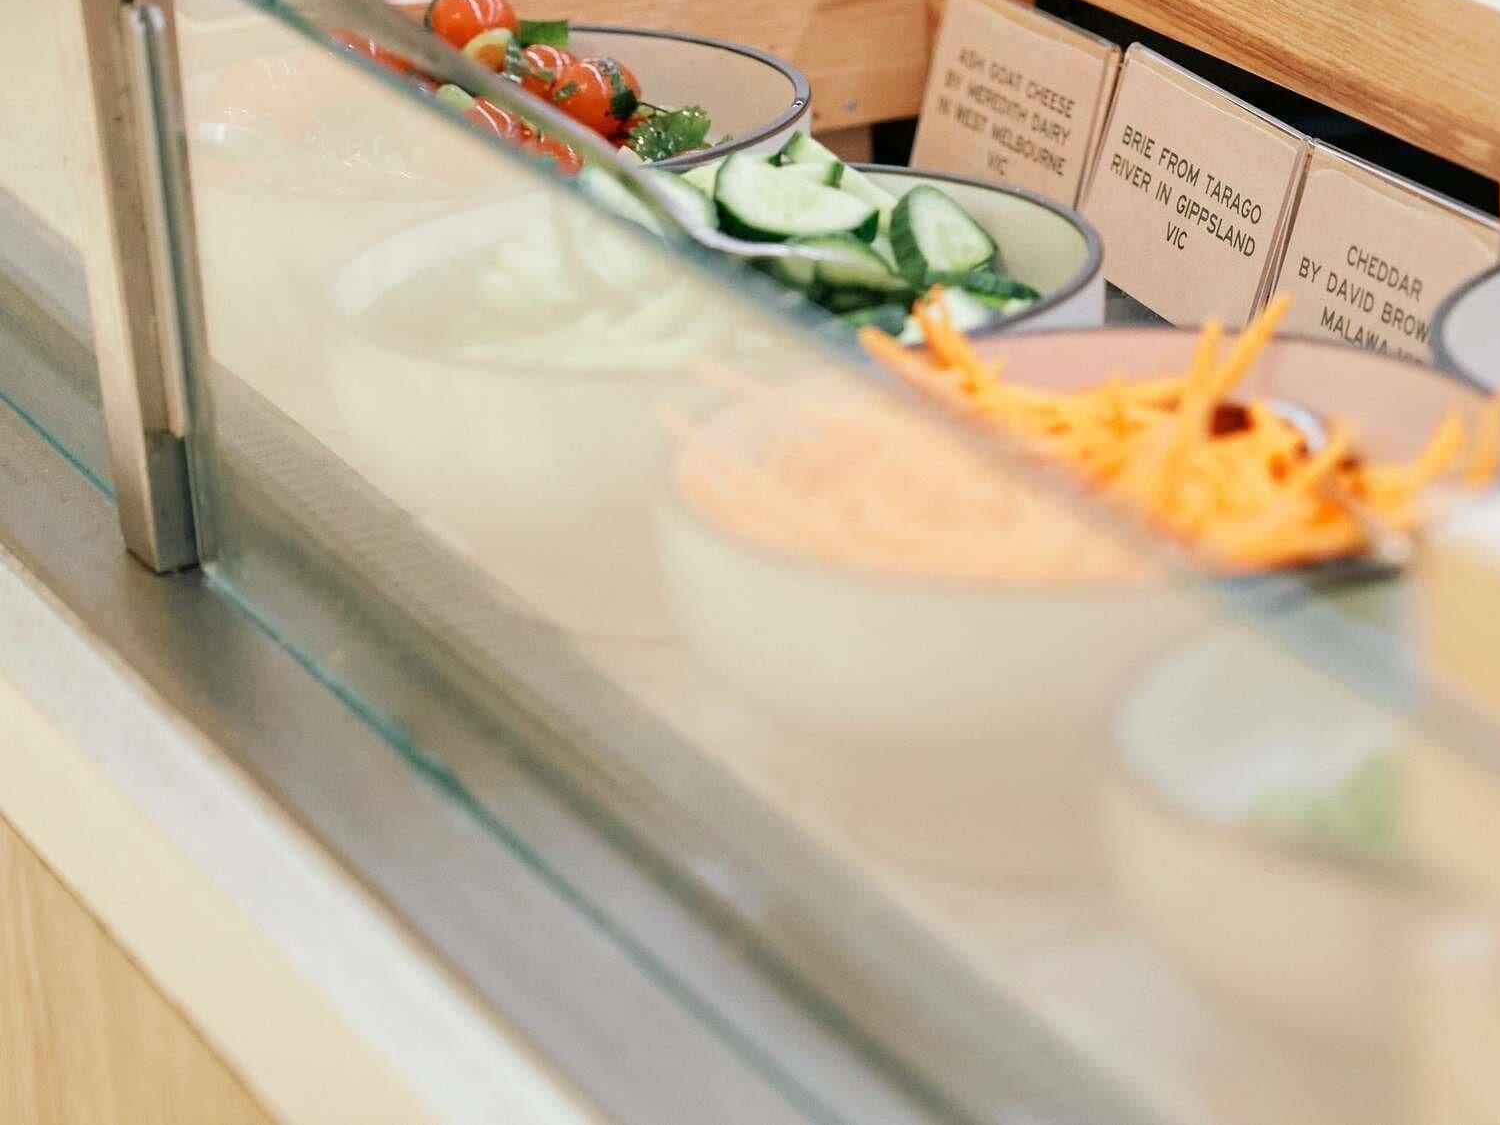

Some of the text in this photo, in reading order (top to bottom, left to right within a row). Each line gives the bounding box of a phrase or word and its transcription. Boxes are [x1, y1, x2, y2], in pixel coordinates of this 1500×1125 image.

[944, 68, 1072, 146] BY MEREDITH DAIRY
[989, 62, 1024, 90] GOAT
[1025, 80, 1076, 119] CHEESE
[937, 96, 1067, 177] IN WEST MELBOURNE
[987, 150, 1009, 176] VIC
[1121, 125, 1262, 225] BRIE FROM TARAGO
[1110, 154, 1256, 258] RIVER IN GIPPSLAND
[1165, 221, 1188, 250] VIC
[1298, 257, 1431, 343] BY DAVID BROW
[1347, 245, 1424, 302] CHEDDAR
